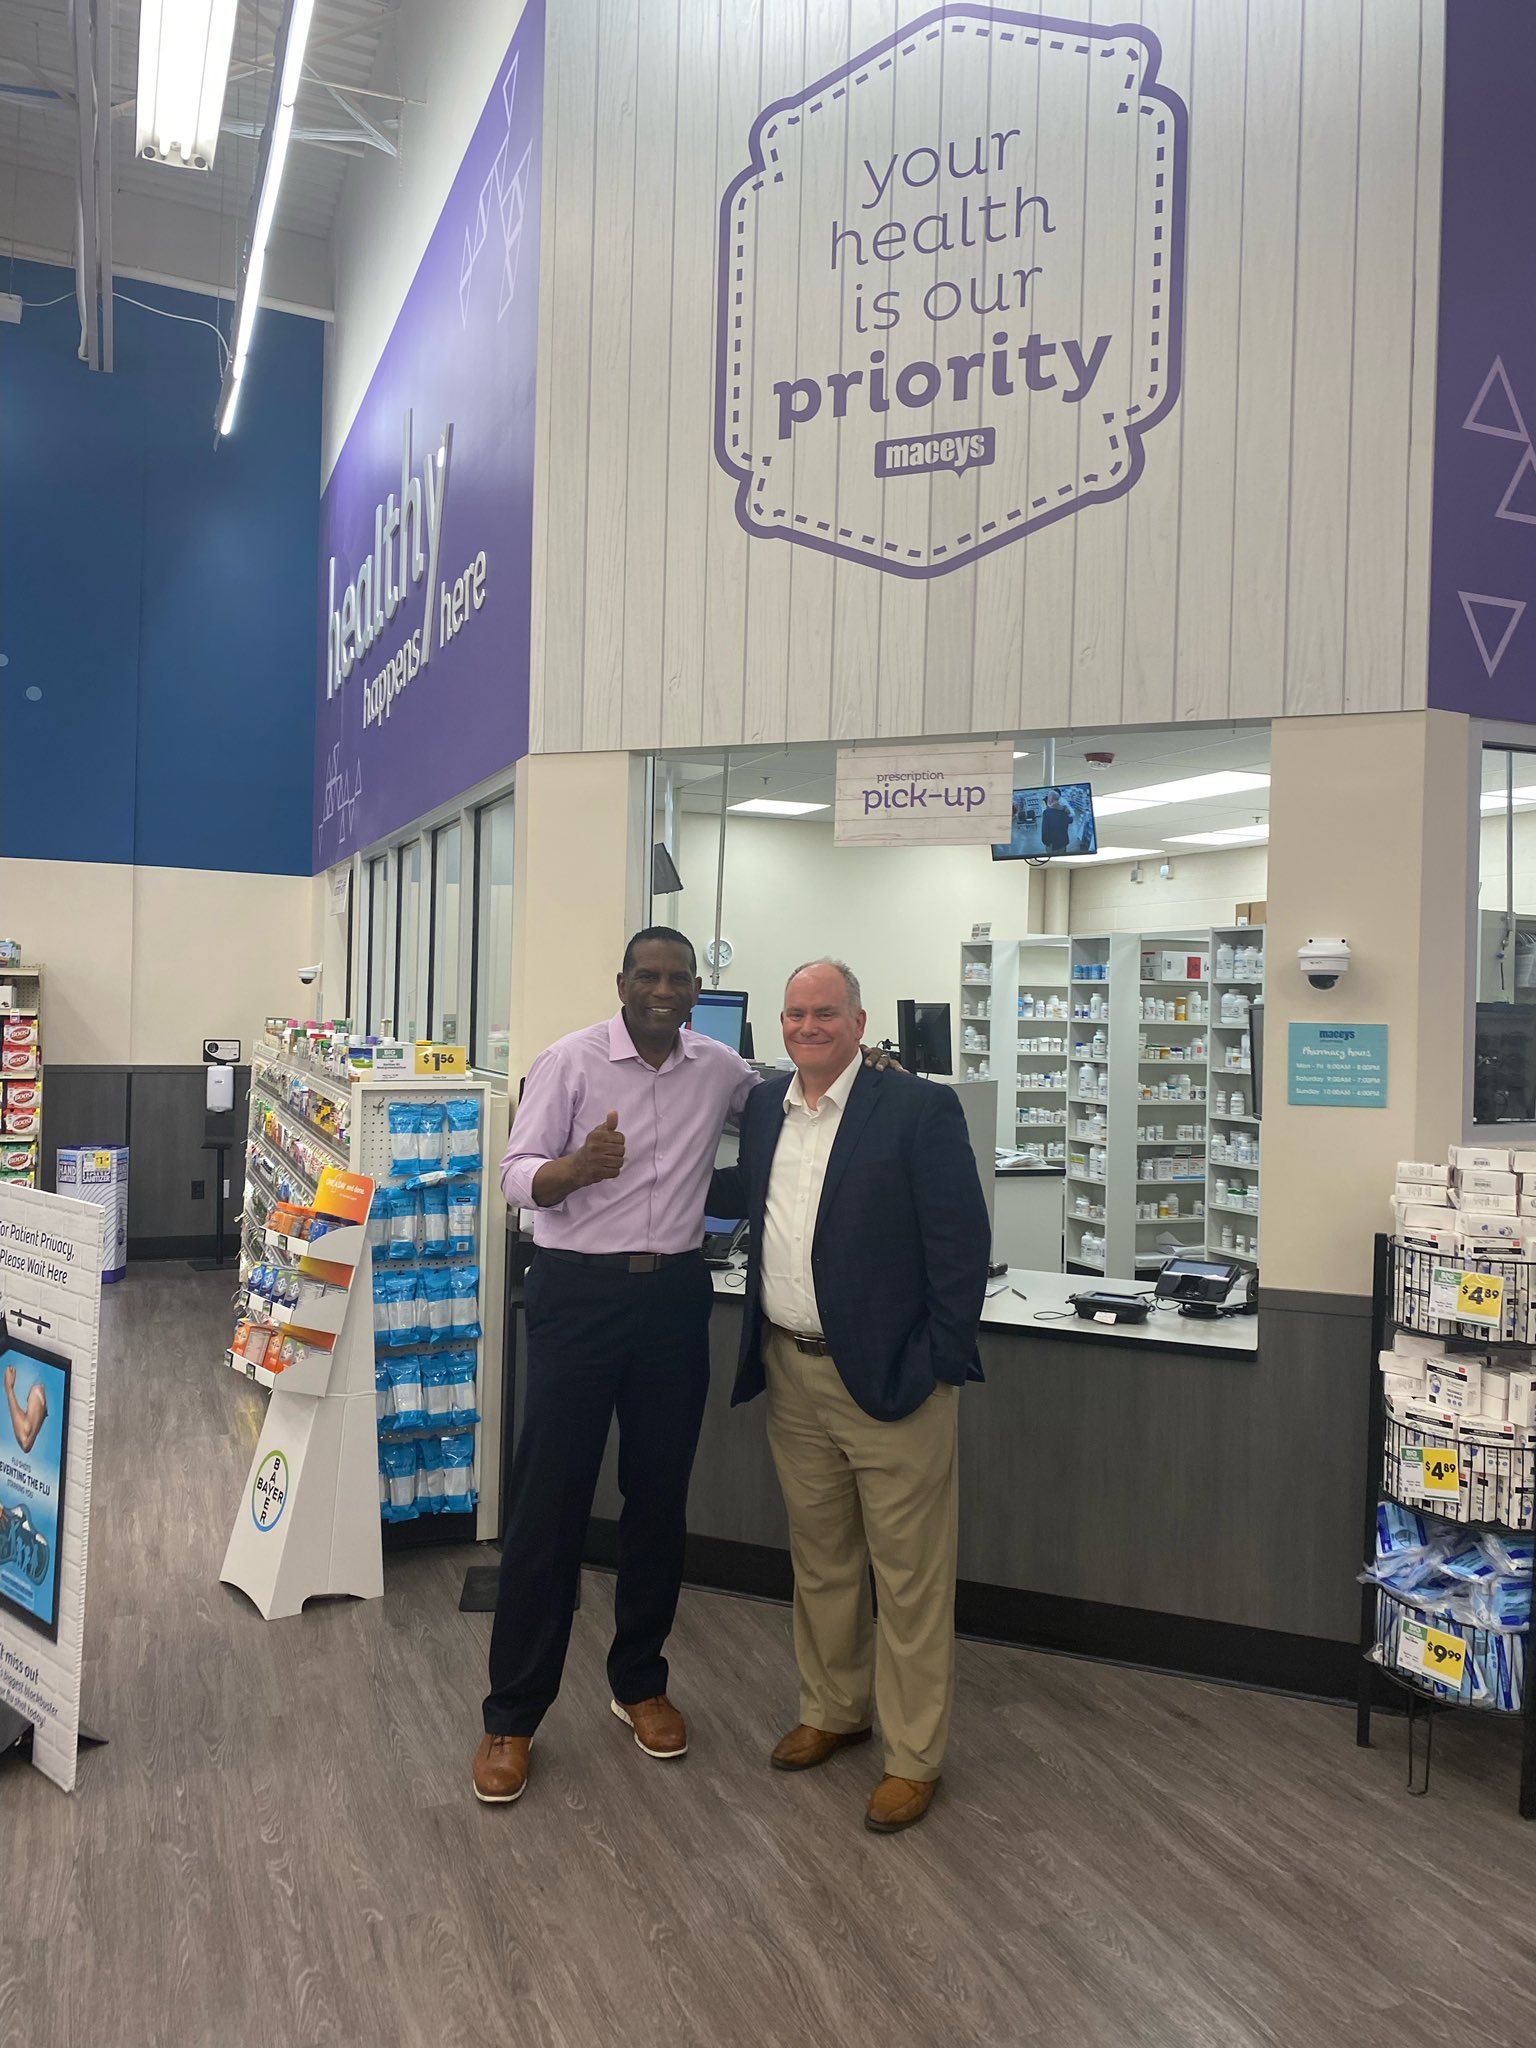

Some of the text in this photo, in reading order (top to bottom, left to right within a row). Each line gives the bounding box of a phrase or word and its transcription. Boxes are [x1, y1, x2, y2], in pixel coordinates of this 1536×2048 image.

[862, 128, 1021, 210] your
[829, 186, 1056, 271] health
[854, 266, 1043, 334] is our
[773, 331, 1113, 440] priority
[885, 433, 985, 470] maceys
[327, 408, 455, 701] healthy
[362, 550, 488, 730] happens here
[876, 770, 945, 784] prescription
[862, 782, 986, 815] pick-up
[1319, 1030, 1355, 1040] maceys
[10, 1224, 39, 1247] Patient
[40, 1232, 74, 1262] Privacy,
[0, 1249, 68, 1284] Please Wait Here
[27, 1475, 38, 1491] THE
[39, 1482, 51, 1496] FLU
[256, 1477, 284, 1504] BAYER
[259, 1457, 281, 1525] BAYER
[5, 1652, 23, 1673] miss
[25, 1666, 39, 1685] out
